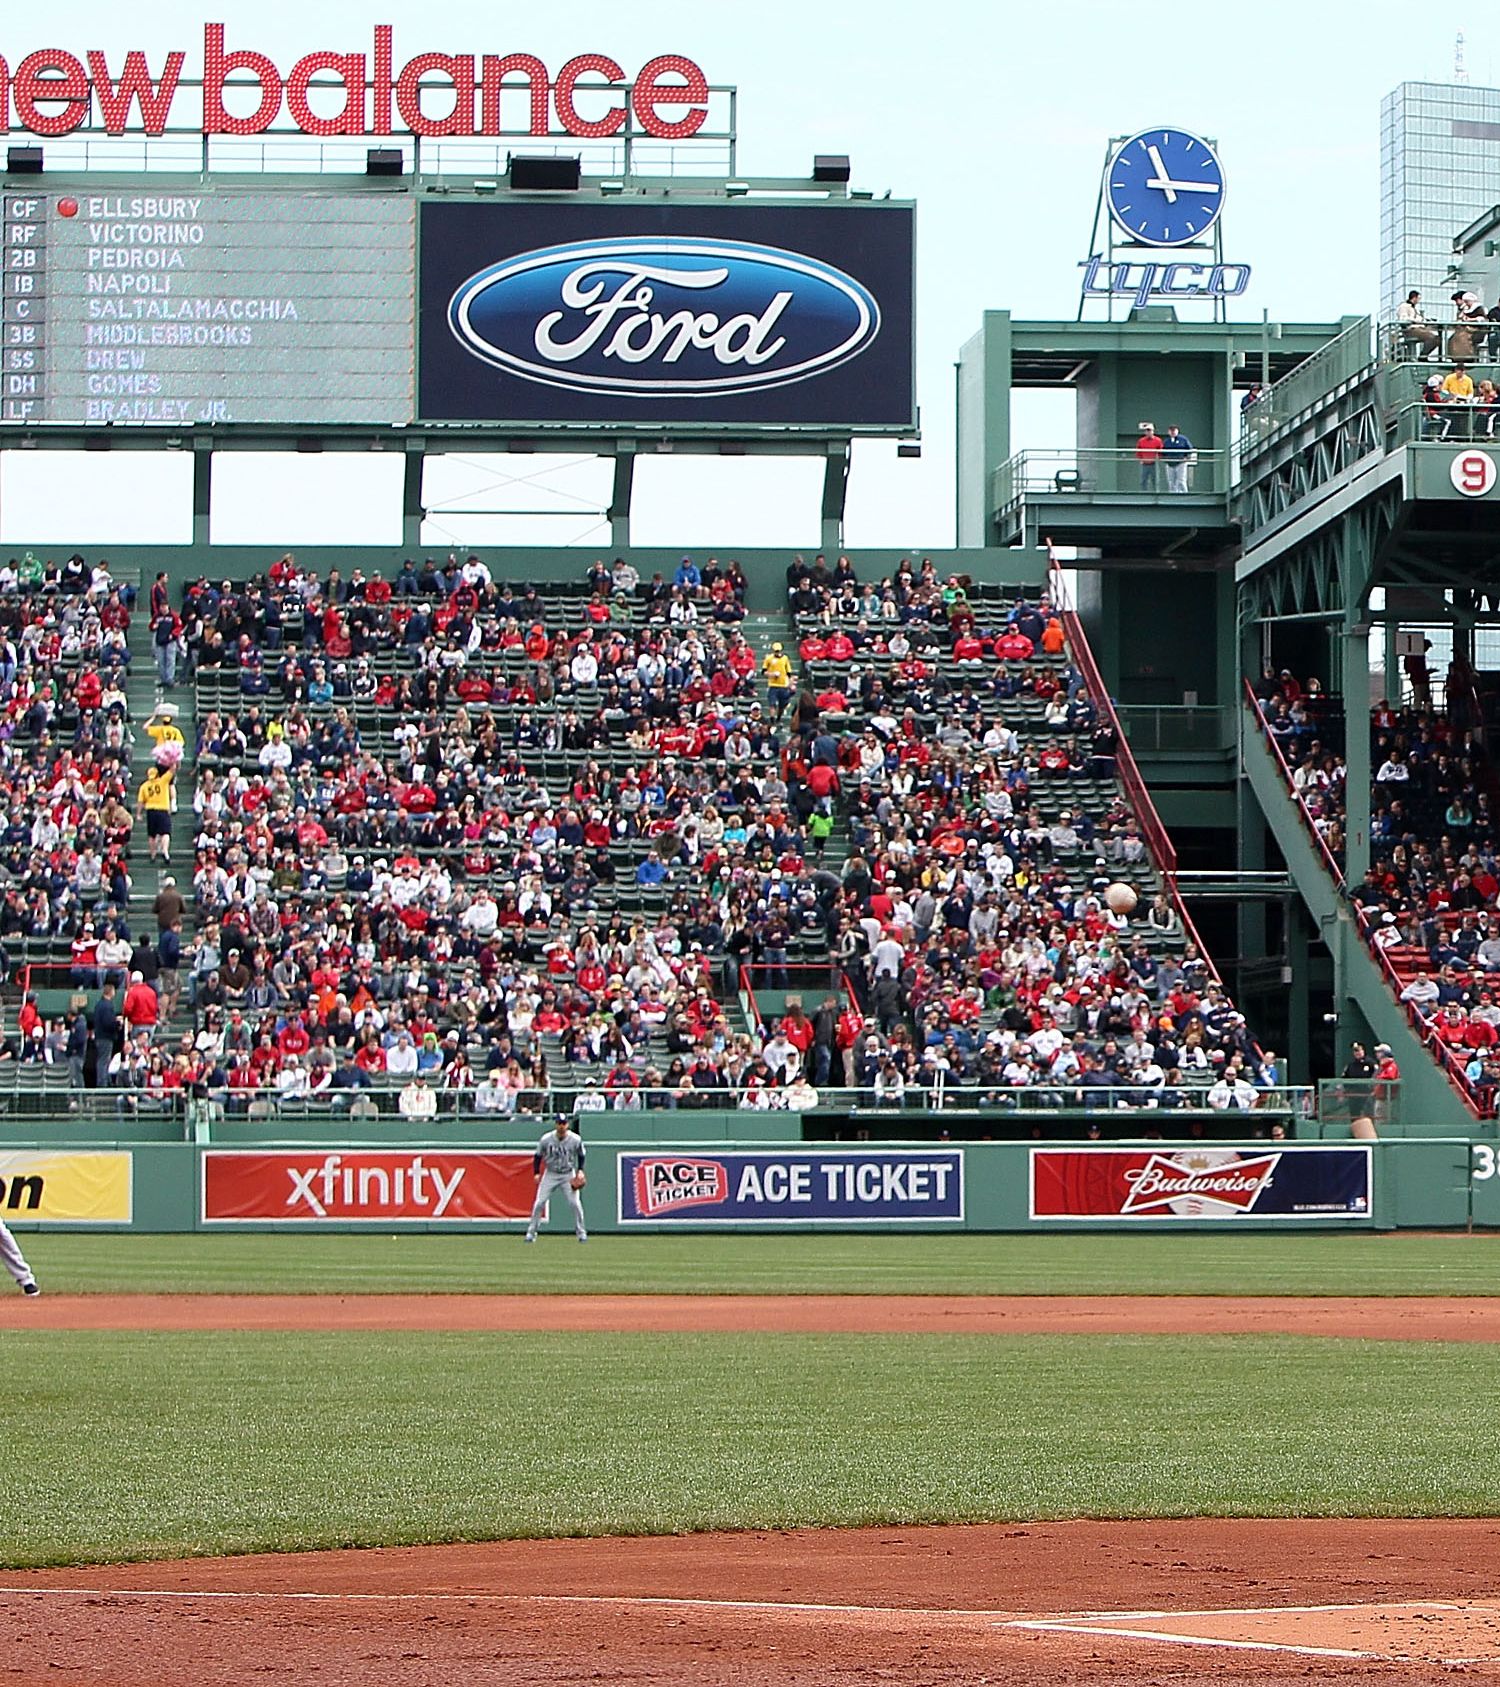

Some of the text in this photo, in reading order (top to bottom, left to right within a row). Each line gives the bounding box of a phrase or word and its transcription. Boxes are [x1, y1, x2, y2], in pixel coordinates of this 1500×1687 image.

[0, 22, 709, 140] ew balance
[12, 200, 202, 218] CF ELLSBURY
[11, 224, 204, 243] RF VICTORINO
[11, 249, 185, 267] 2B PEDROIA
[88, 275, 172, 293] NAPOLI
[1077, 252, 1251, 309] tyco
[16, 300, 298, 319] C SALTALAMACCHIA
[534, 265, 794, 365] Ford
[10, 325, 252, 345] 3B MIDDLEBROOKS
[10, 350, 146, 369] SS DREW
[9, 375, 162, 394] DH GOMES
[9, 401, 233, 420] LF BRADLEY JR.
[1462, 457, 1486, 491] 9
[652, 1164, 717, 1186] ACE
[736, 1163, 953, 1203] ACE TICKET
[1123, 1169, 1274, 1196] Budweiser
[286, 1157, 465, 1216] xfinity
[655, 1184, 717, 1204] TICKET
